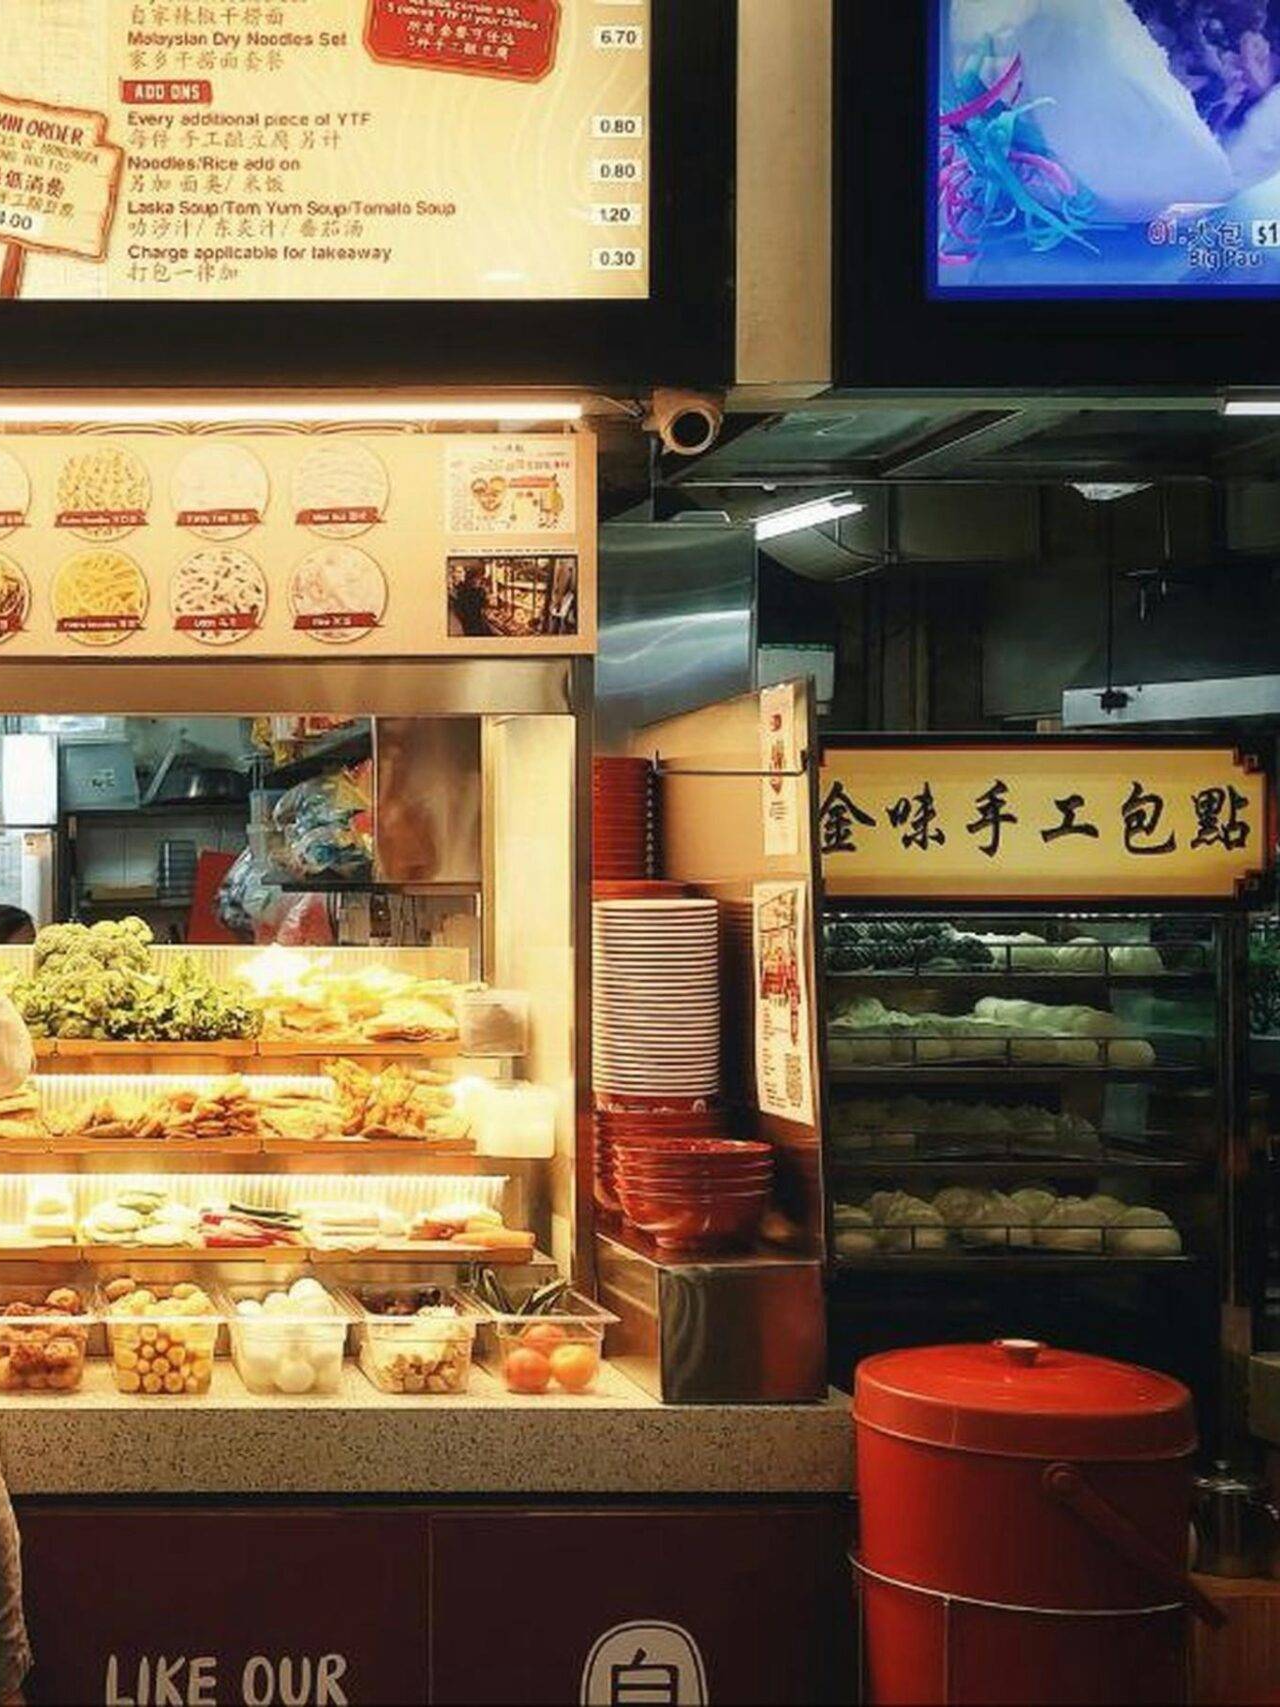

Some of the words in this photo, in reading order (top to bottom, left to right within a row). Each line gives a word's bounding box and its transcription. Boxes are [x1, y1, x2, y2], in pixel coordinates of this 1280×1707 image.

[127, 31, 208, 48] Malaysian
[213, 31, 240, 49] Dry
[247, 31, 313, 46] Noodles
[319, 32, 347, 46] Set
[600, 31, 636, 44] 6.70
[134, 84, 164, 99] ADD
[171, 84, 201, 99] ONS
[127, 112, 172, 129] Every
[181, 112, 259, 126] additional
[264, 112, 309, 129] piece
[314, 112, 330, 126] of
[337, 113, 372, 126] YTF
[600, 120, 635, 133] 0.80
[26, 121, 84, 146] ORDER
[243, 157, 274, 171] add
[279, 159, 300, 171] on
[600, 164, 635, 178] 0.80
[127, 201, 172, 216] Laska
[179, 201, 260, 219] Soup/Tom
[266, 201, 302, 216] Yum
[307, 201, 411, 219] Soup/Tomato
[416, 201, 456, 220] Soup
[601, 208, 630, 222] 1.20
[127, 245, 188, 263] Charge
[194, 245, 278, 263] applicable
[283, 245, 305, 259] for
[311, 245, 392, 263] takeaway
[600, 251, 635, 266] 0.30
[1189, 249, 1218, 269] Big
[1224, 250, 1262, 267] Pau
[820, 779, 1250, 857] 金味手工包點
[105, 1654, 217, 1707] LIKE
[242, 1654, 349, 1707] OUR
